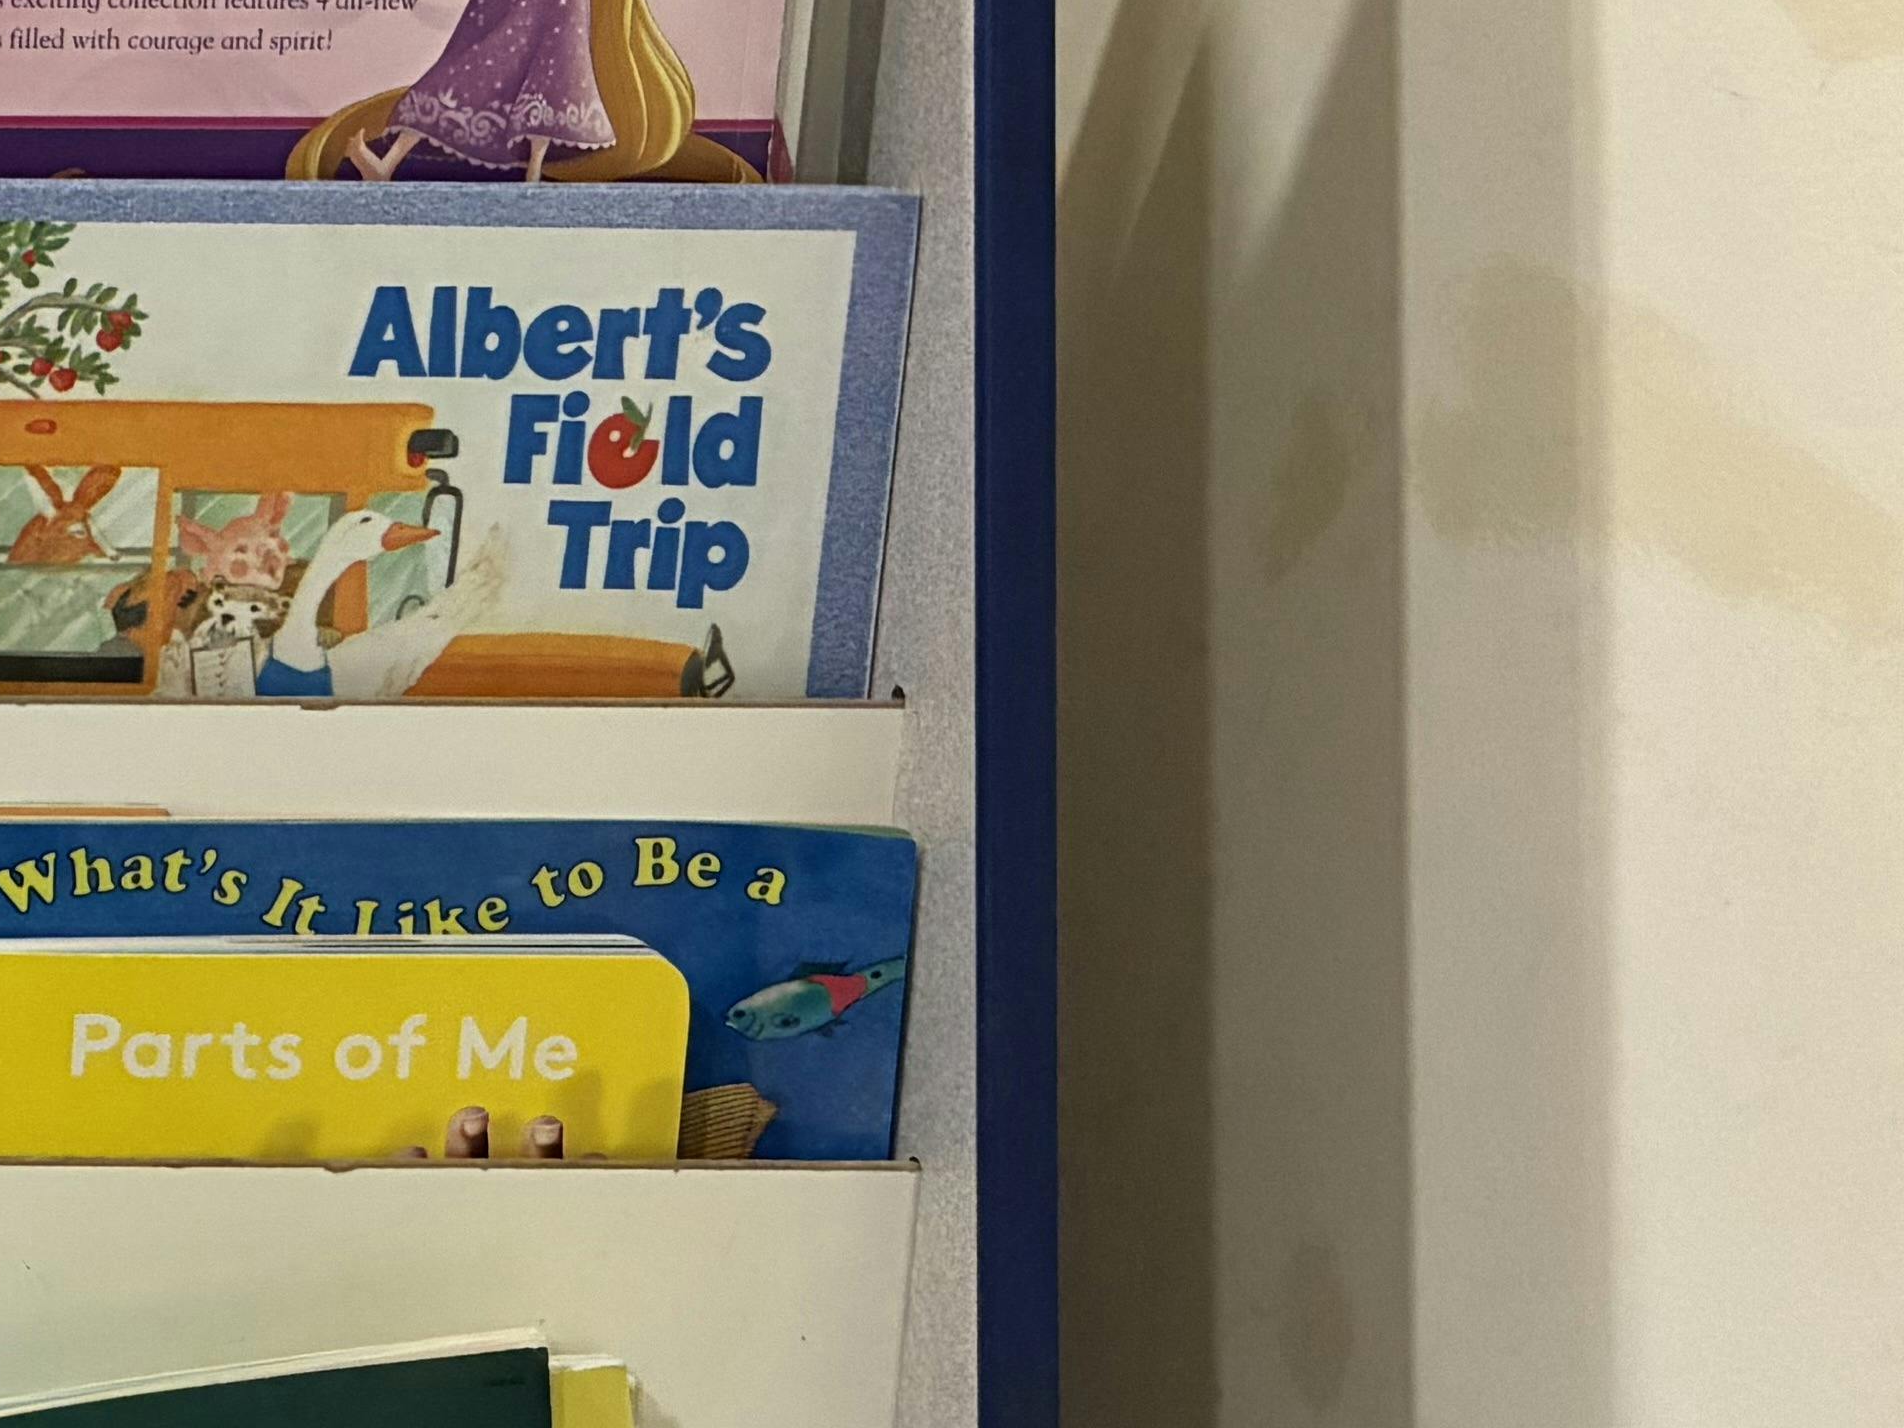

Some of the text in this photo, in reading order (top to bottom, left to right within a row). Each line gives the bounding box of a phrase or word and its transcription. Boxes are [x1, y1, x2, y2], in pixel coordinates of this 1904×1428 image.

[9, 27, 65, 51] filled
[71, 28, 121, 52] with
[127, 31, 214, 54] courage
[220, 29, 263, 52] and
[269, 29, 333, 55] spirit!
[347, 286, 772, 381] Albert's
[503, 390, 763, 489] Field
[547, 497, 750, 609] Trip
[259, 876, 328, 936] It
[529, 854, 604, 910] to
[630, 835, 722, 891] Be
[745, 863, 788, 908] a
[69, 1012, 579, 1082] Parts of Me
